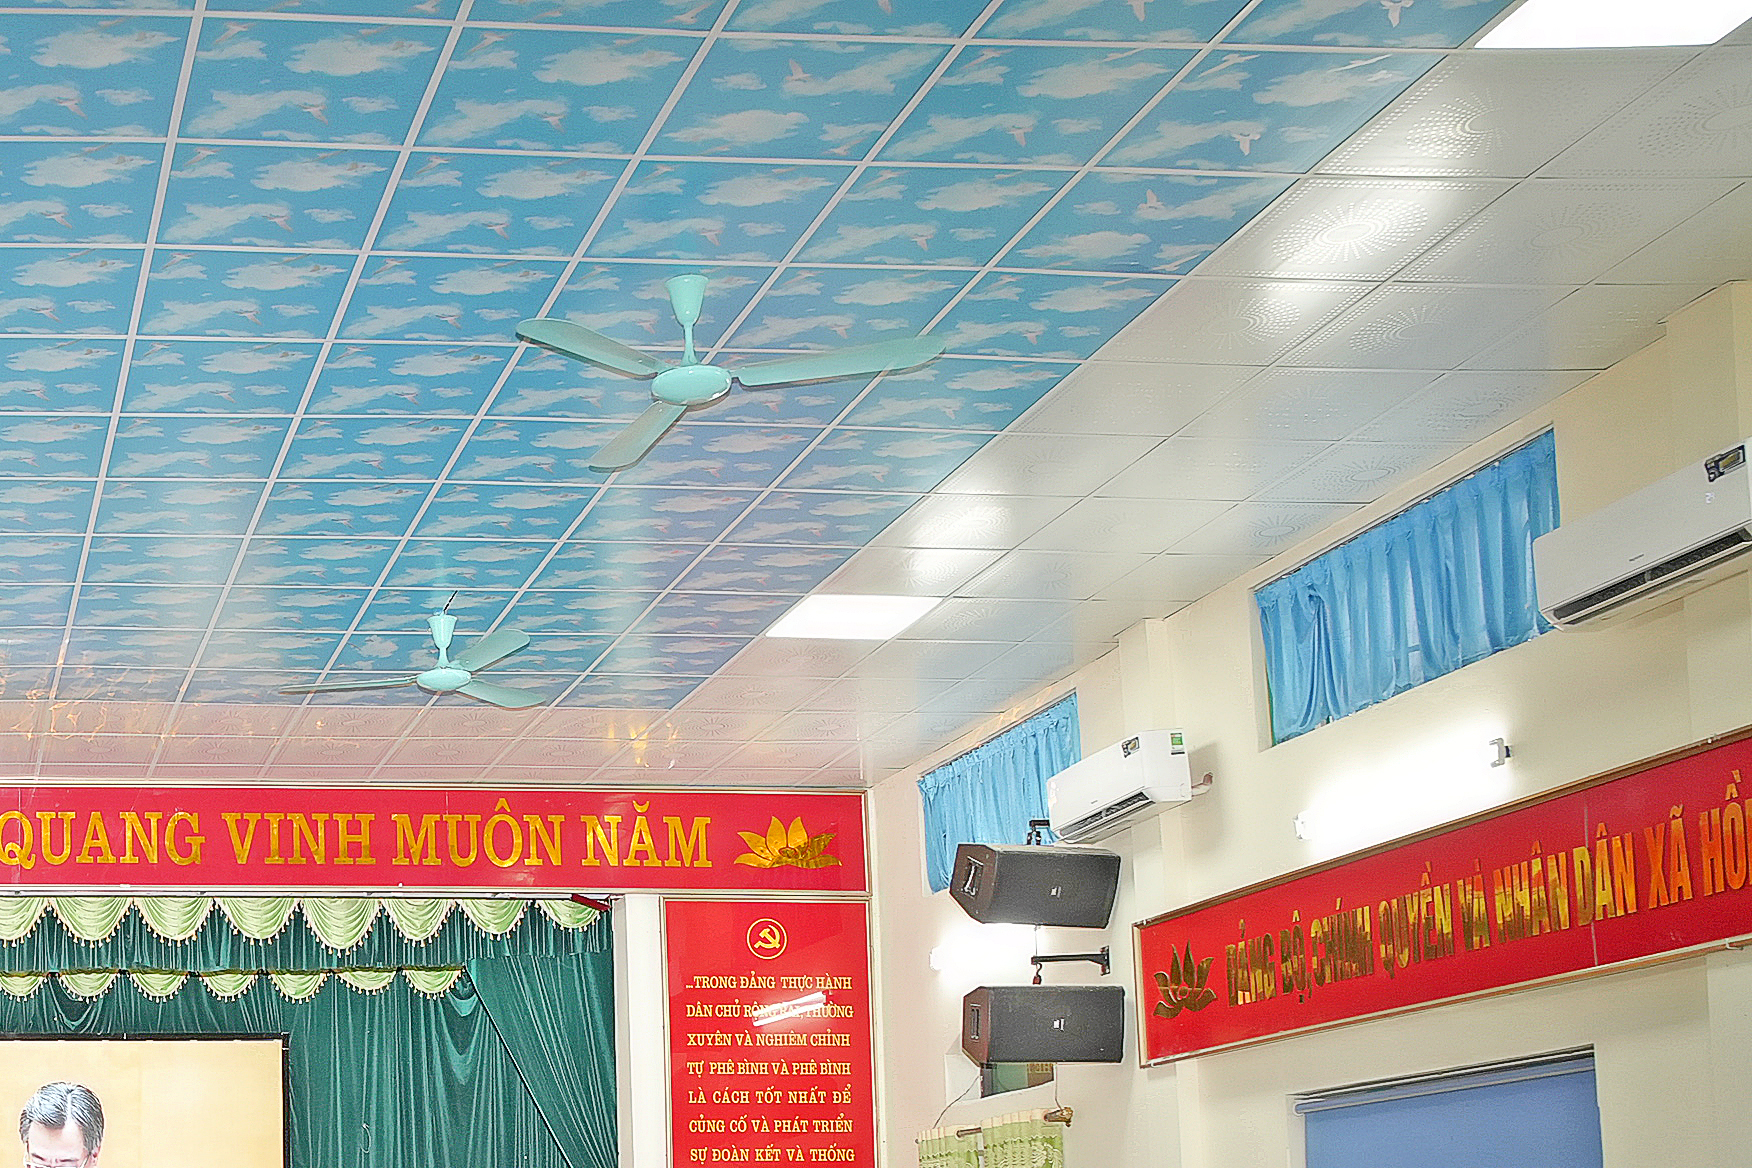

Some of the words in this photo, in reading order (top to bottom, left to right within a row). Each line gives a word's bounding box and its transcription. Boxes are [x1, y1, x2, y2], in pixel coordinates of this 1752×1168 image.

[221, 810, 377, 866] VINH
[392, 798, 563, 868] MUÔN
[581, 799, 712, 868] NĂM
[1226, 918, 1276, 1007] ĐẢNG
[1280, 910, 1313, 1004] BỘ,
[1311, 897, 1374, 987] CHÍNH
[1379, 861, 1454, 979] QUYỀN
[1457, 858, 1491, 952] VÀ
[1493, 839, 1570, 943] NHÂN
[1573, 822, 1638, 925] DÂN
[1644, 800, 1693, 909] XÃ
[740, 971, 776, 989] ĐẢNG
[781, 975, 813, 991] THỰC
[816, 973, 852, 989] HÀNH
[686, 1001, 713, 1018] DÂN
[715, 999, 741, 1018] CHỦ
[687, 1031, 732, 1046] XUYÊN
[735, 1031, 753, 1046] VÀ
[756, 1031, 807, 1046] NGHIÊM
[810, 1029, 850, 1046] CHỈNH
[687, 1060, 704, 1078] TỰ
[709, 1059, 734, 1075] PHÊ
[737, 1059, 769, 1074] BÌNH
[771, 1059, 789, 1074] VÀ
[792, 1059, 817, 1074] PHÊ
[820, 1059, 851, 1074] BÌNH
[688, 1087, 706, 1103] LÀ
[713, 1087, 749, 1103] CÁCH
[756, 1086, 782, 1103] TỐT
[788, 1086, 826, 1103] NHẤT
[832, 1084, 852, 1103] ĐỂ
[689, 1114, 725, 1132] CỦNG
[730, 1115, 748, 1132] CỐ
[751, 1116, 770, 1132] VÀ
[774, 1116, 808, 1132] PHÁT
[813, 1113, 853, 1132] TRIỂN
[690, 1147, 708, 1164] SỰ
[712, 1145, 749, 1161] ĐOÀN
[755, 1144, 781, 1161] KẾT
[786, 1145, 805, 1161] VÀ
[810, 1143, 855, 1161] THỐNG
